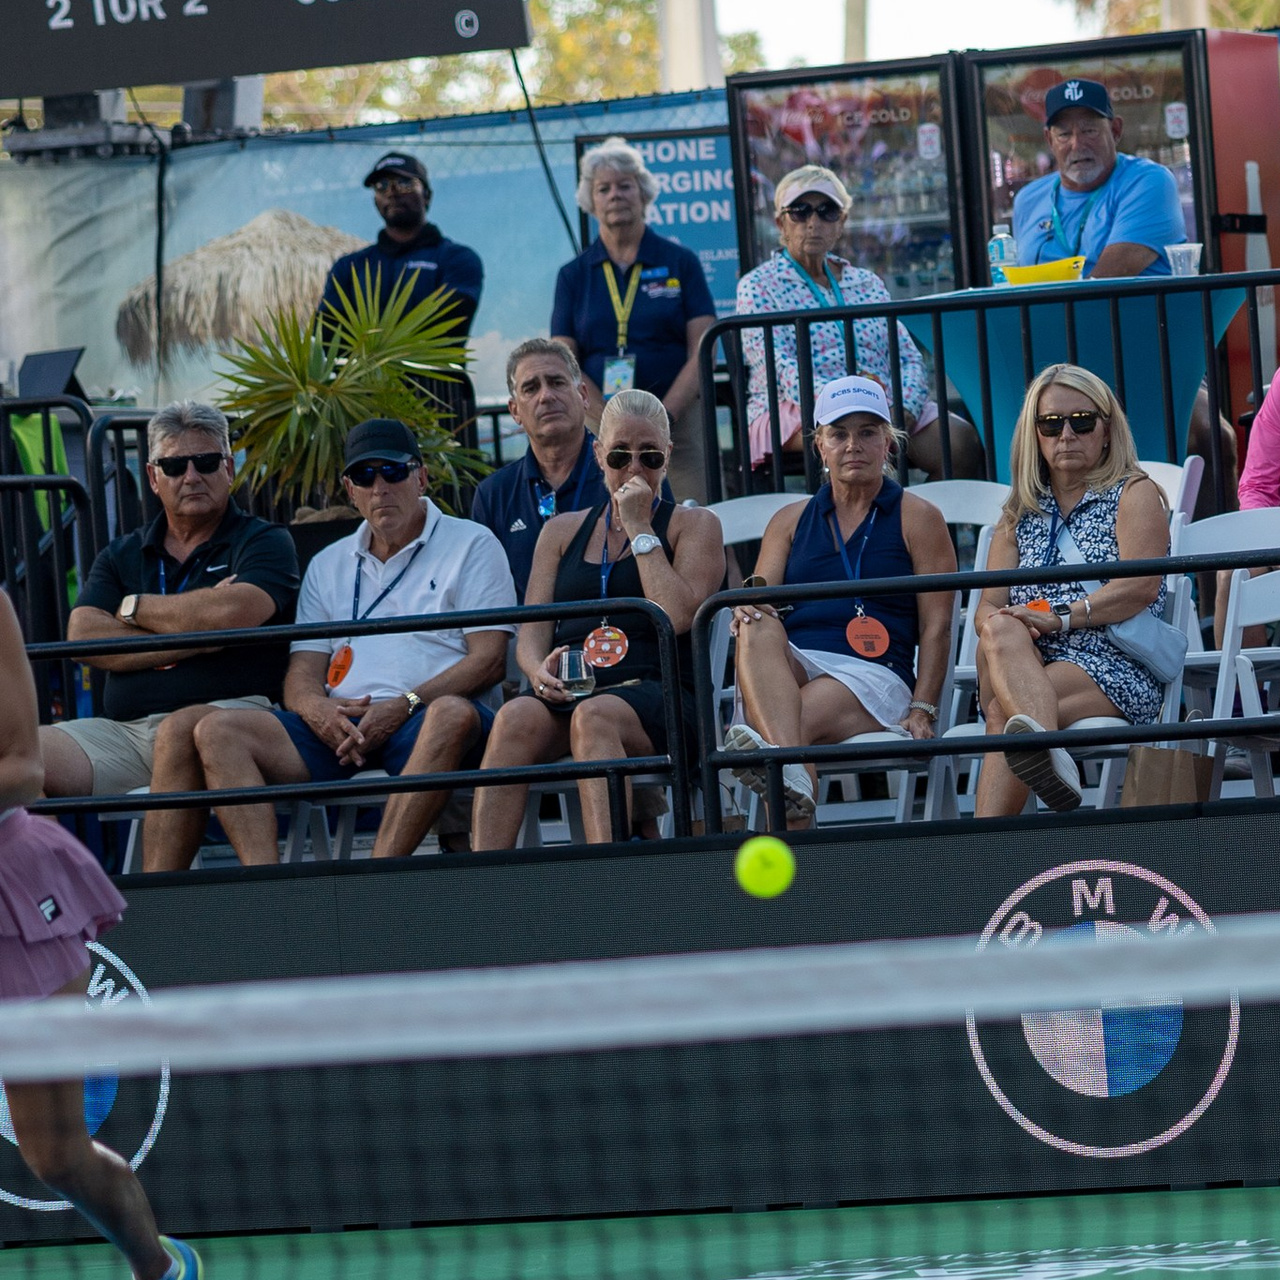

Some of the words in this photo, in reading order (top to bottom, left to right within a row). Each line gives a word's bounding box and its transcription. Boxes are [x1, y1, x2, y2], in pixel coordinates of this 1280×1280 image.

[1112, 85, 1155, 101] COLD
[870, 107, 911, 122] COLD
[639, 138, 716, 164] HONE
[645, 200, 730, 225] ATION
[852, 387, 880, 400] SPORTS
